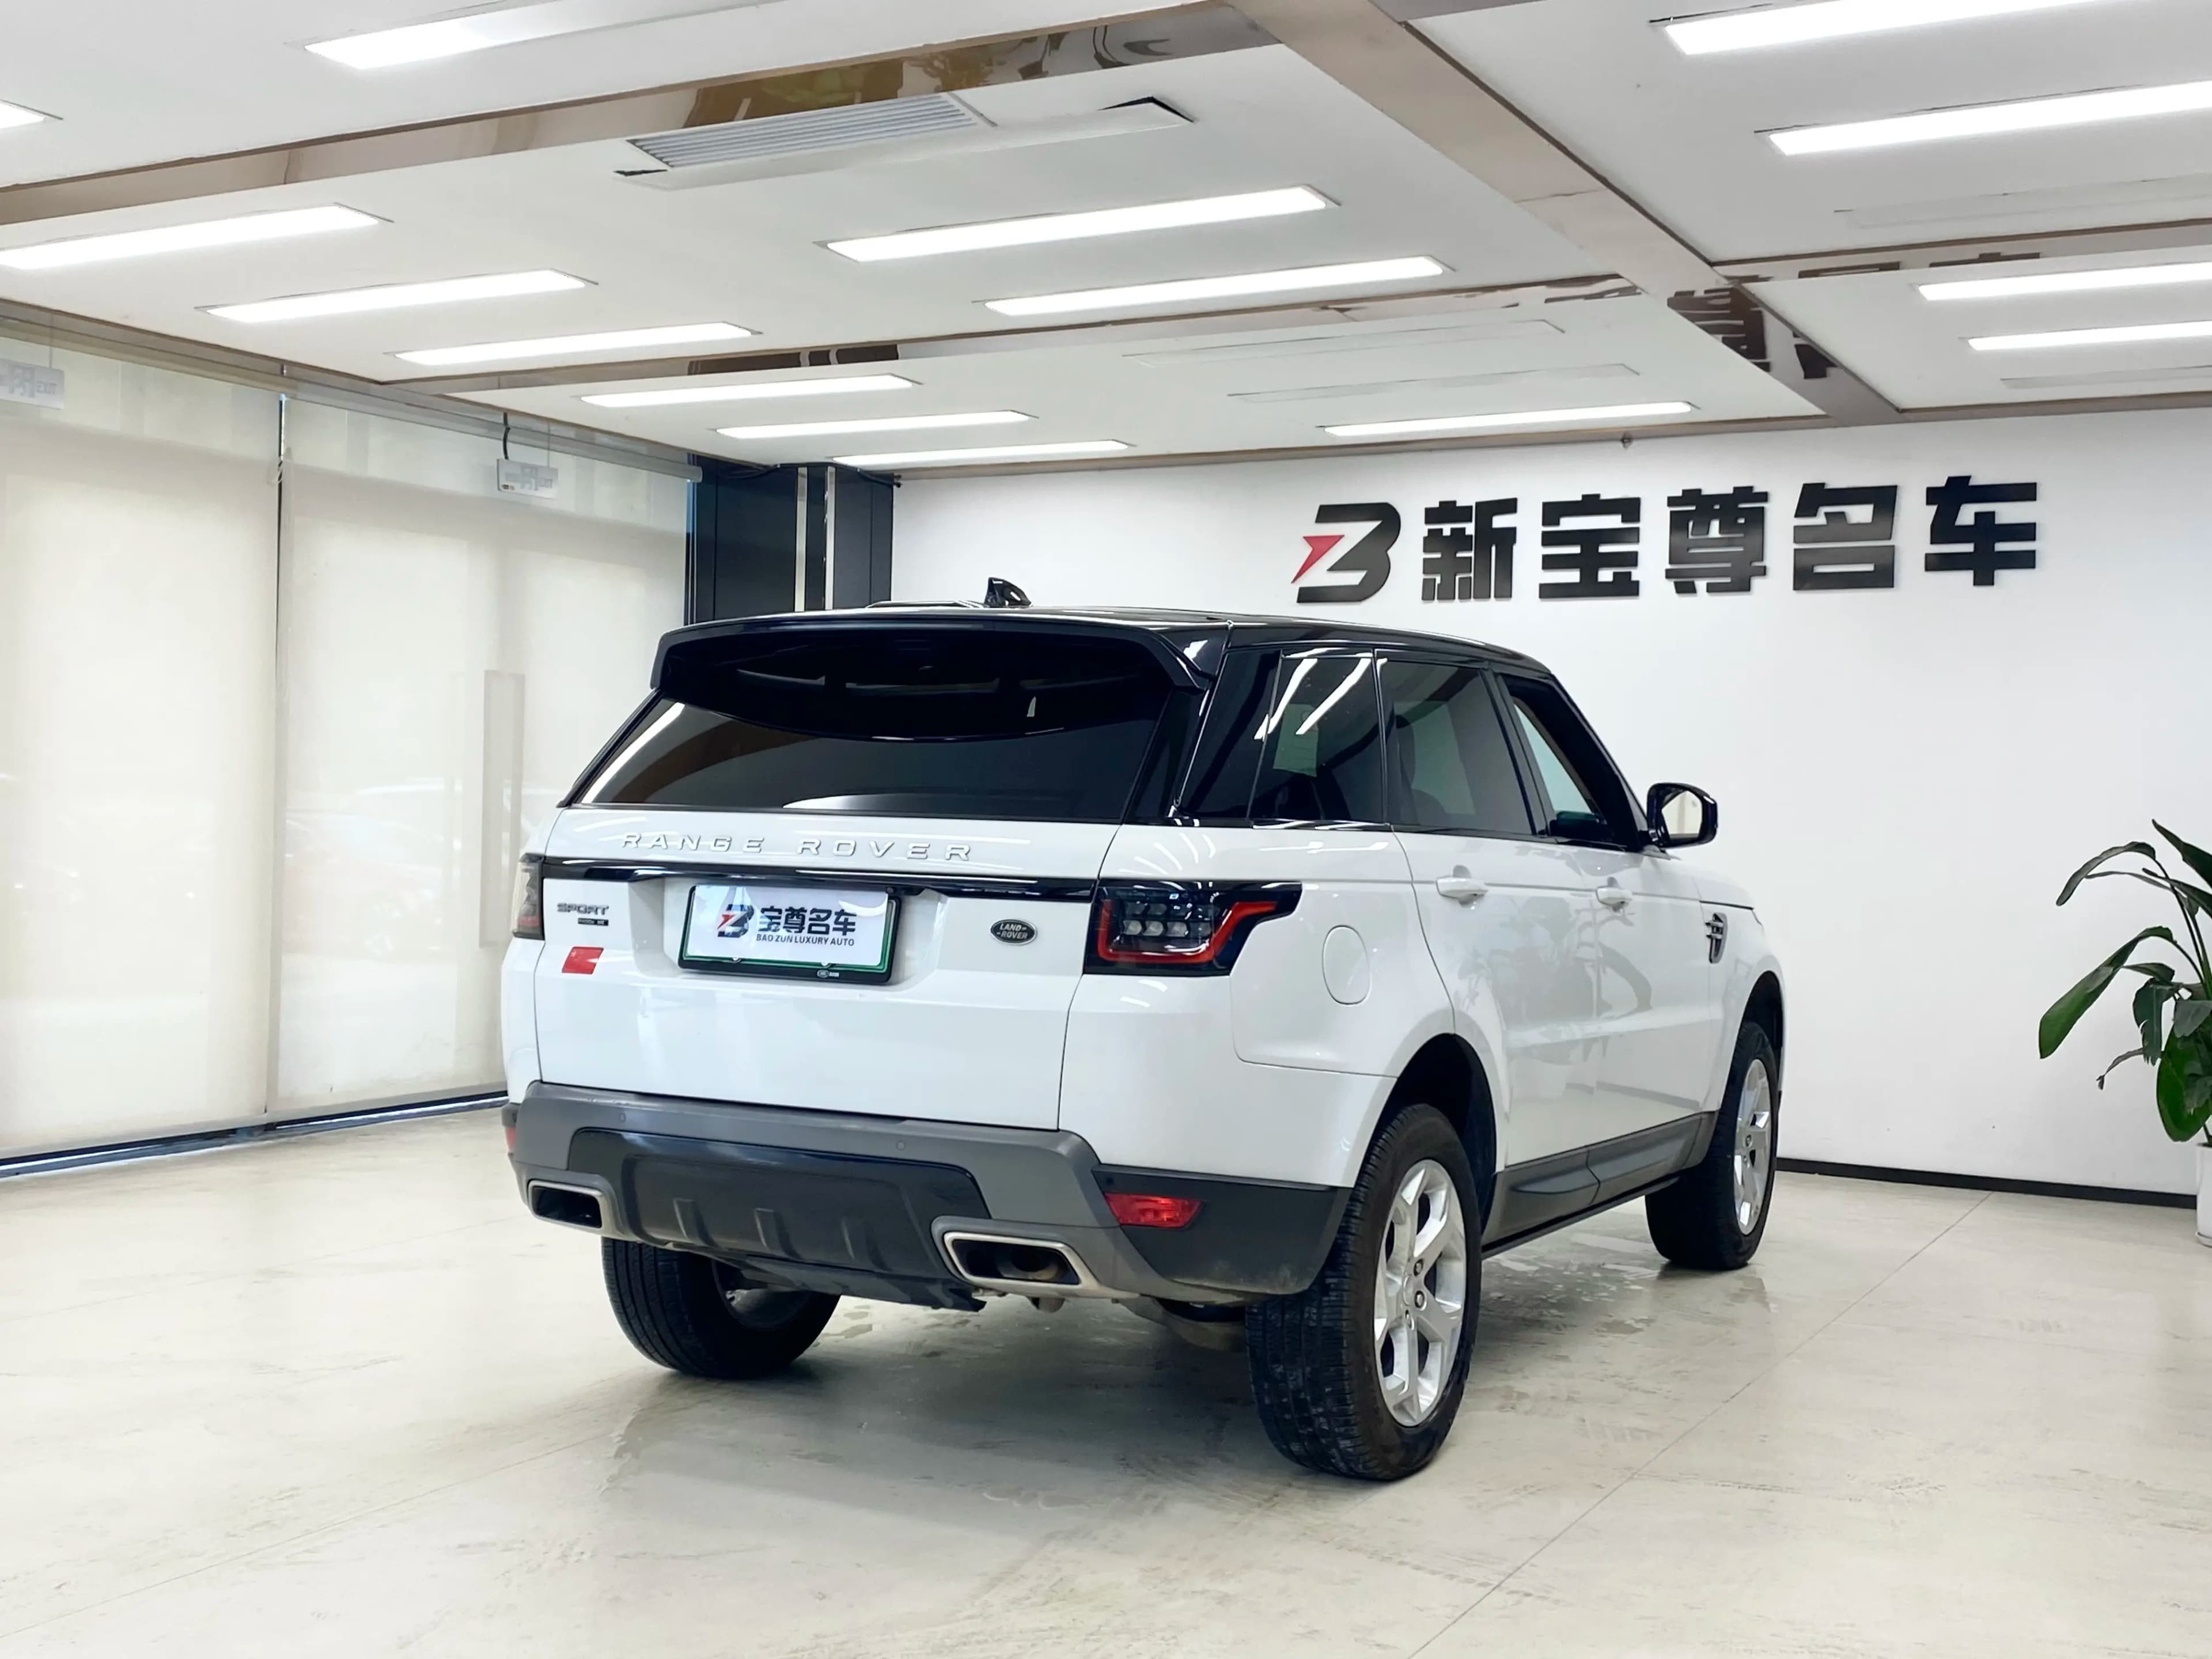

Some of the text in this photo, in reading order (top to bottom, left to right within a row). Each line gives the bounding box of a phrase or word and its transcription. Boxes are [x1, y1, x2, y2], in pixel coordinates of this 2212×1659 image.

[1421, 475, 2037, 602] 新宝尊名车
[622, 832, 971, 861] RANGE ROVER
[556, 902, 610, 915] SPORT
[757, 905, 858, 936] 宝尊名车
[756, 933, 855, 946] BAO ZUN LUXURY AUTO
